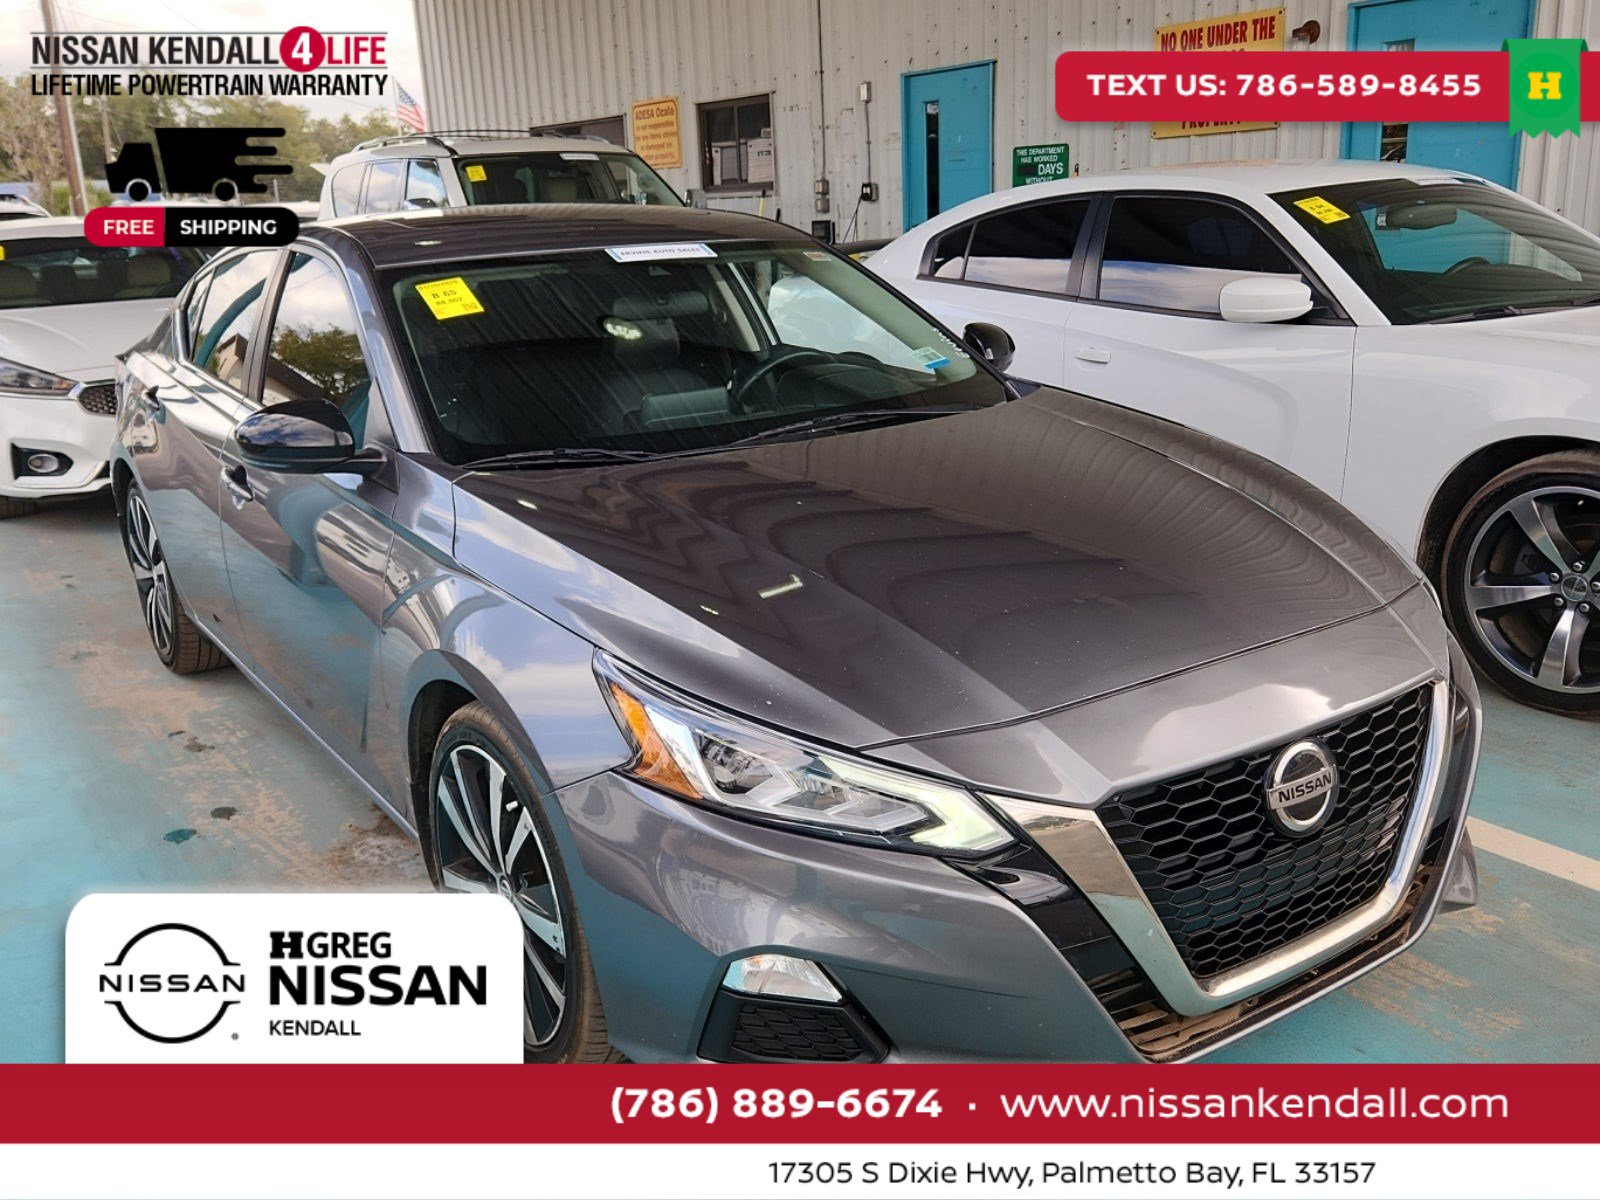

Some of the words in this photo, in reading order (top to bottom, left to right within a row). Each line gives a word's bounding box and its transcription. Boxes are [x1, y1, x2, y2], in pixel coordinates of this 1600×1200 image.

[1161, 32, 1177, 51] NO
[1180, 28, 1203, 51] ONE
[1207, 21, 1248, 48] UNDER
[1252, 16, 1276, 41] THE
[635, 109, 654, 120] ADESA
[655, 106, 674, 117] Ocala
[1028, 147, 1065, 155] DEPARTMENT
[1021, 156, 1032, 164] HAS
[1033, 154, 1058, 163] WORKED
[1038, 162, 1064, 175] DAYS
[1278, 772, 1332, 803] NISSAN
